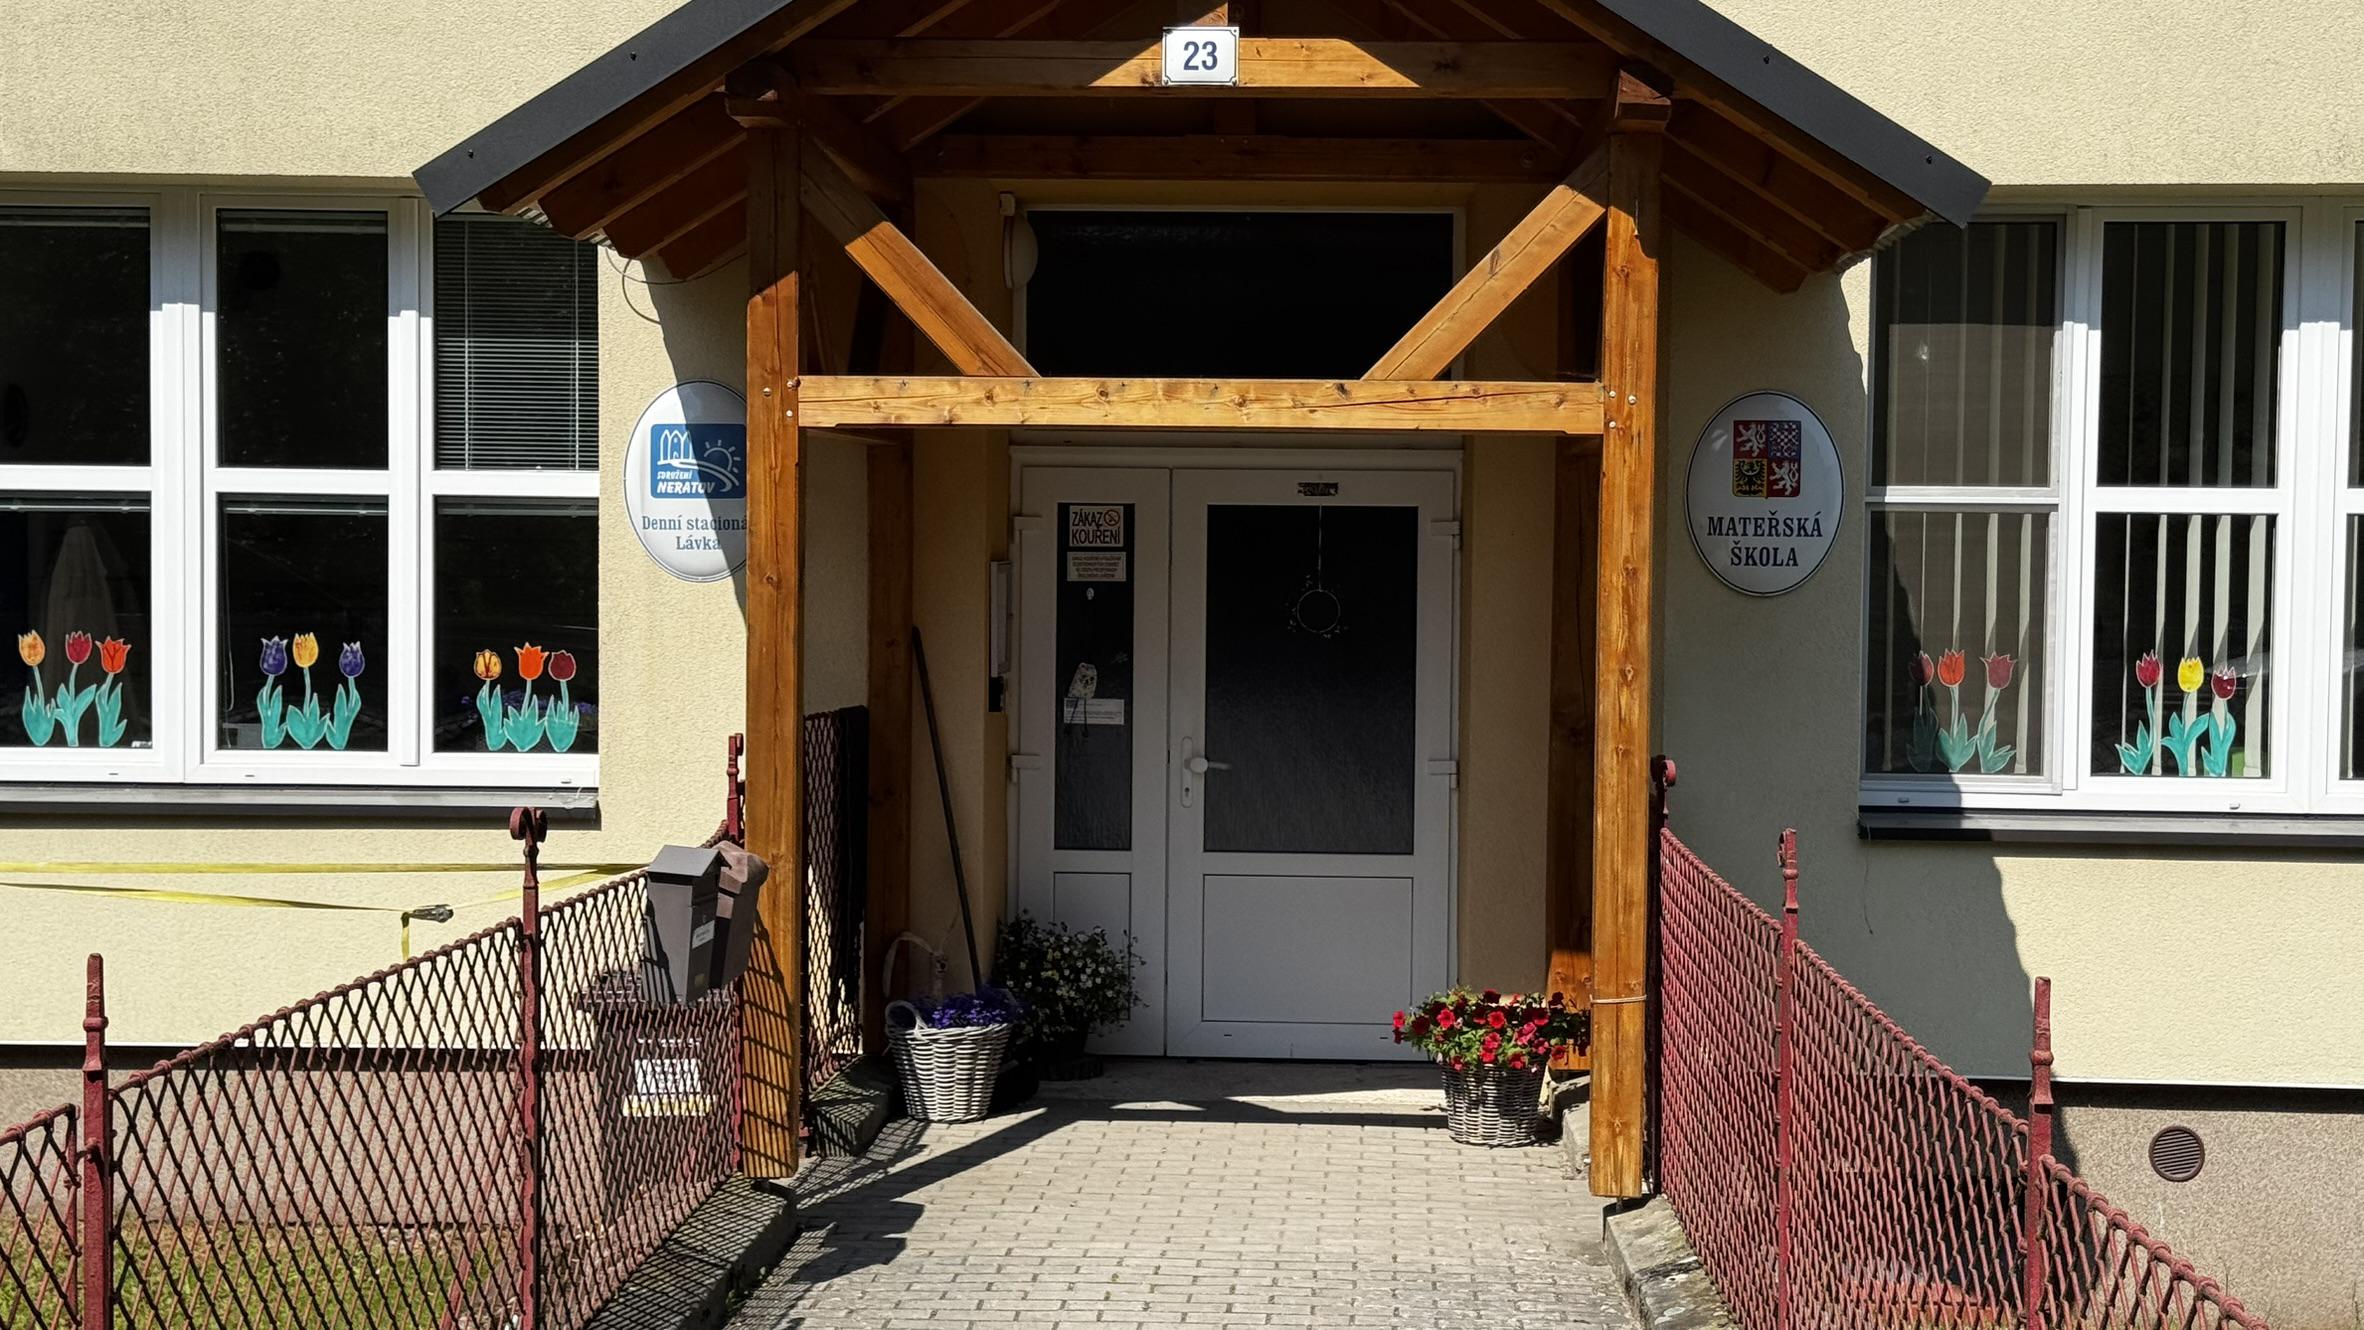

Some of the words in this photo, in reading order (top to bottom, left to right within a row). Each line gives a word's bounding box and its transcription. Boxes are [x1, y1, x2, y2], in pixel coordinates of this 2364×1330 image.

[1183, 41, 1218, 71] 23
[656, 481, 716, 494] NERATOV
[642, 515, 682, 530] Denní
[686, 515, 748, 531] stacioná
[1072, 508, 1104, 527] ZÁKAZ
[1707, 510, 1823, 538] MATEŘSKÁ
[676, 534, 722, 550] Lávka
[1071, 526, 1120, 544] KOUŘENÍ
[1730, 540, 1799, 567] ŠKOLA
